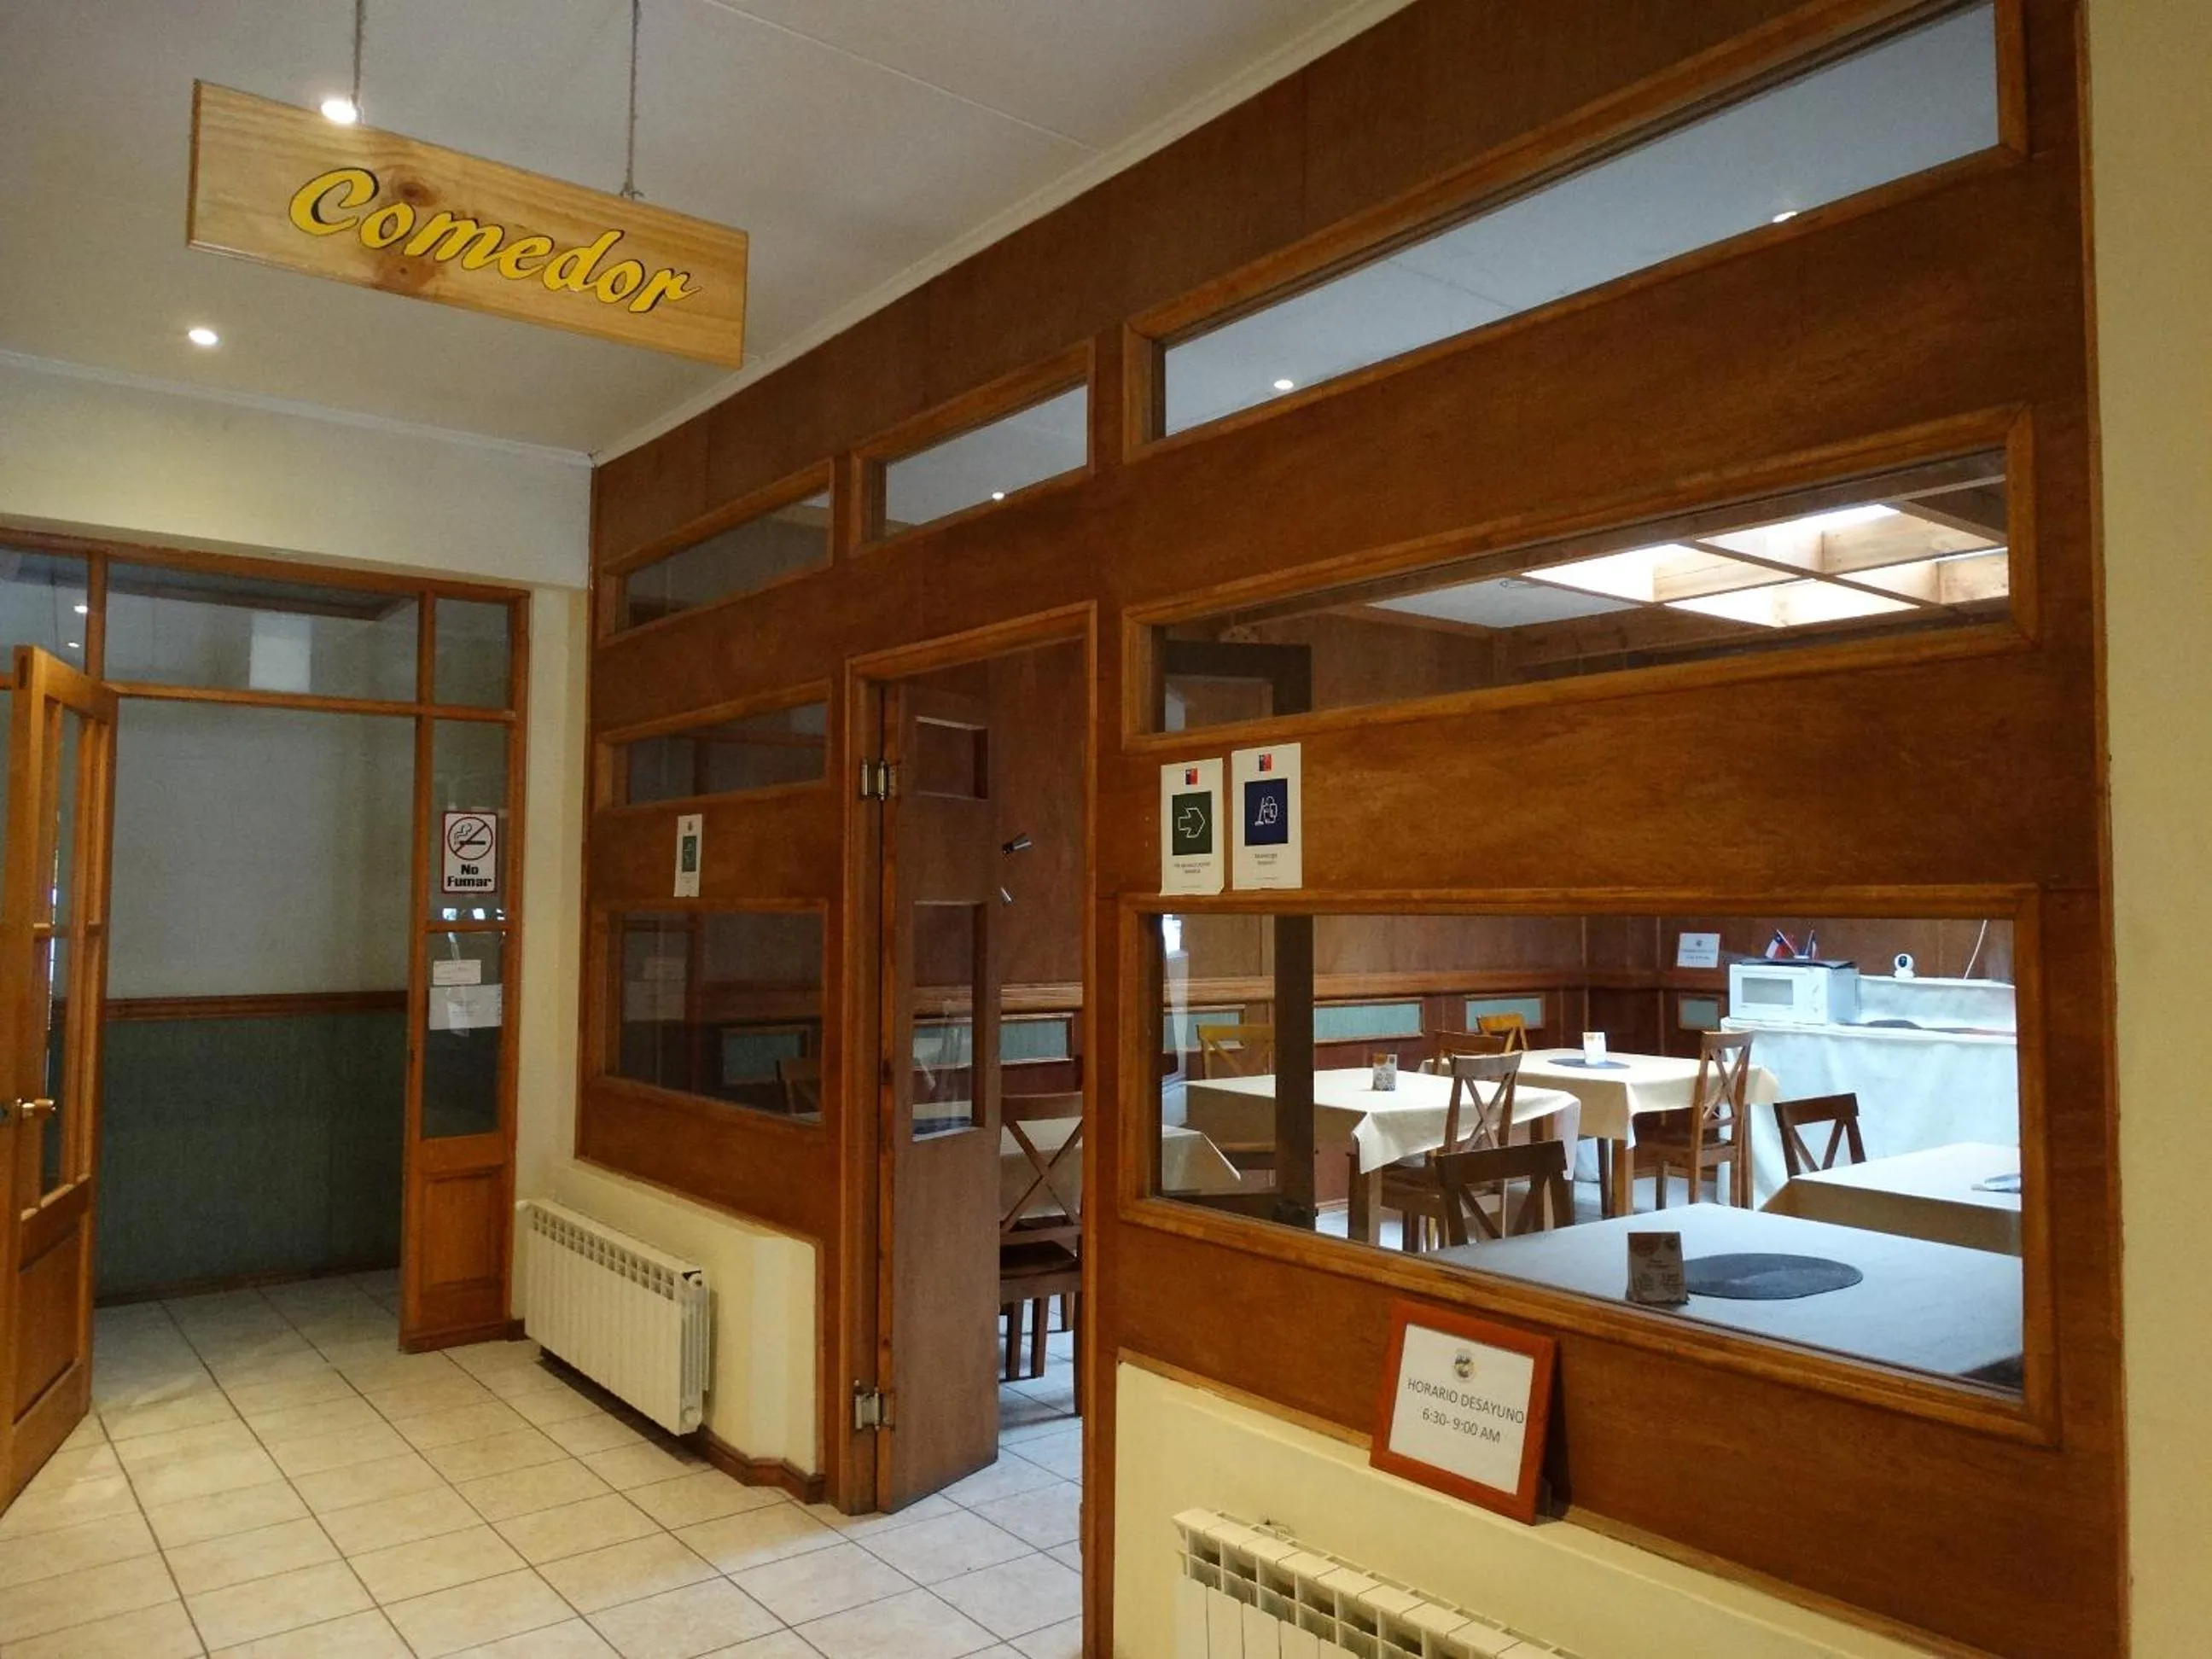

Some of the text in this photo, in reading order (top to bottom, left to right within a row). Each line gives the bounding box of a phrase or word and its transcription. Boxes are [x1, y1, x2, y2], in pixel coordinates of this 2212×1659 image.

[288, 166, 701, 313] Comedor
[447, 876, 492, 887] Fumar
[461, 864, 479, 875] No
[1407, 1378, 1524, 1424] HORARIO DESAYUNO
[1452, 1417, 1478, 1436] 9:00
[1480, 1426, 1500, 1444] AM
